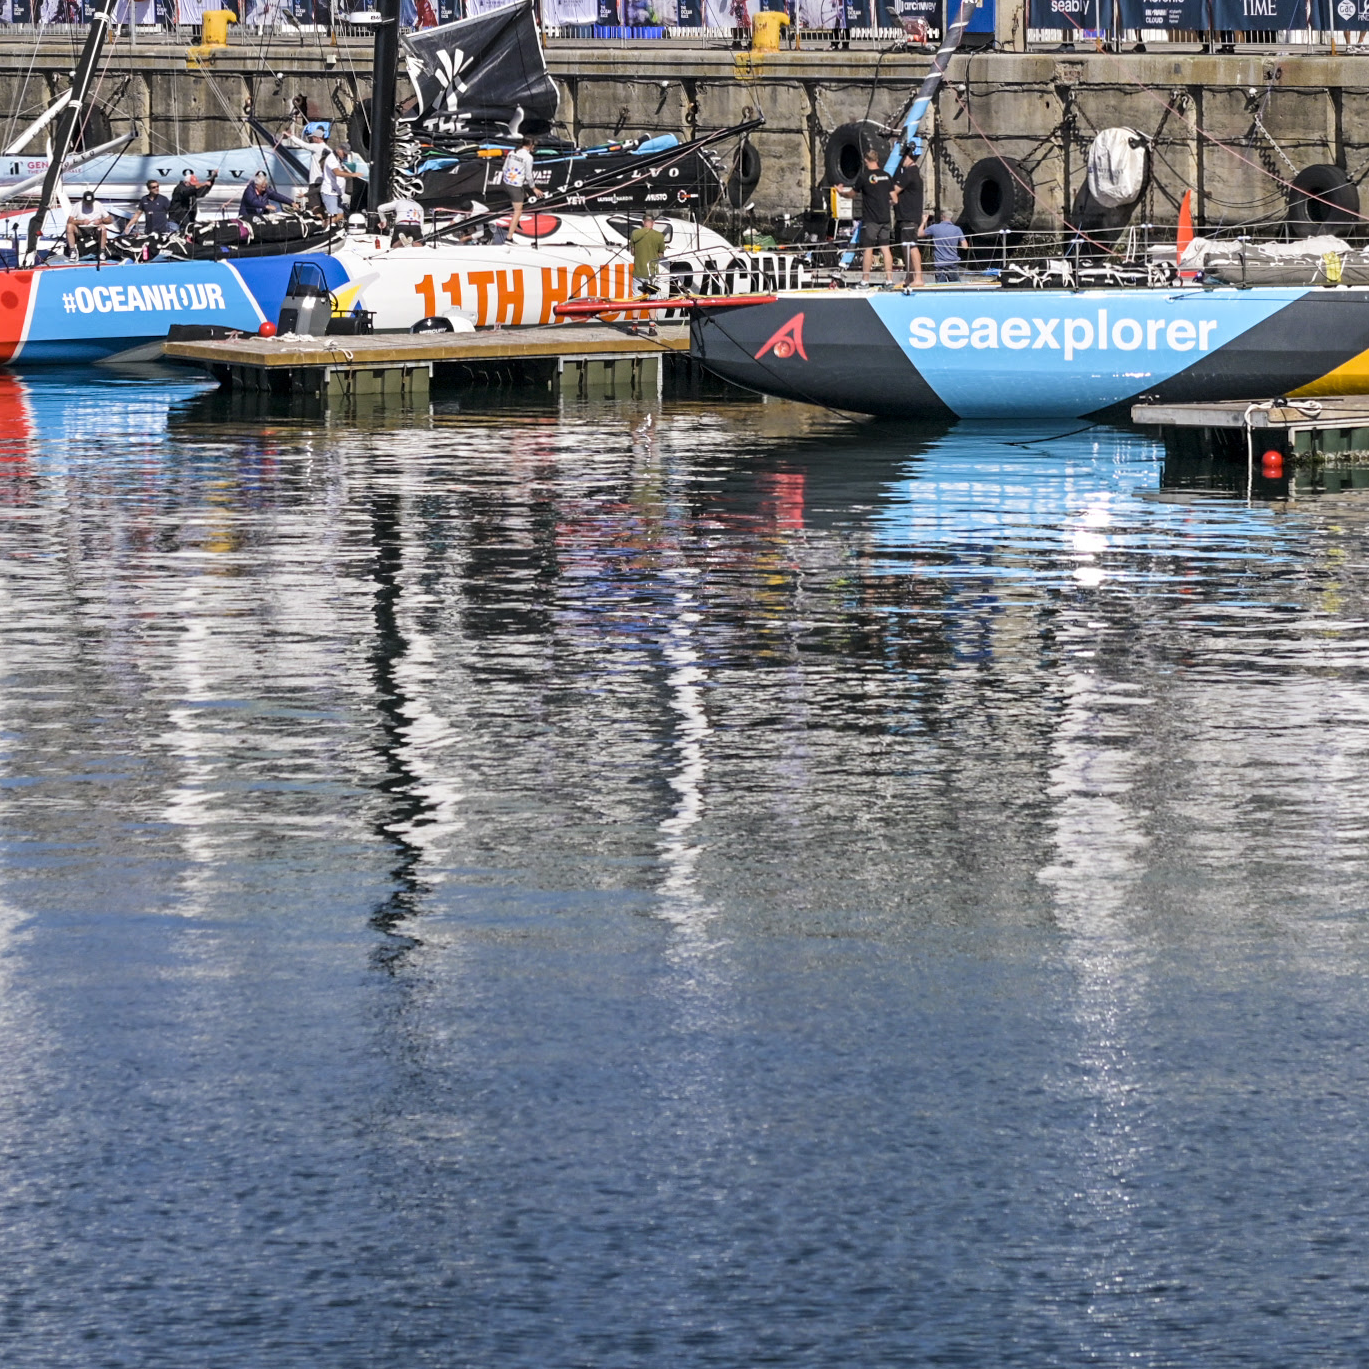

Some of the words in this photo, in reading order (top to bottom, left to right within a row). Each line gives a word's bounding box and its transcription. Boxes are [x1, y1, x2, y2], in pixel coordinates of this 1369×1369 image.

[904, 0, 937, 13] archwey
[424, 113, 473, 134] THE
[645, 192, 669, 202] MUSTO
[62, 283, 226, 314] #OCEANHOUR
[415, 268, 525, 327] 11TH
[908, 308, 1217, 361] seaexplorer
